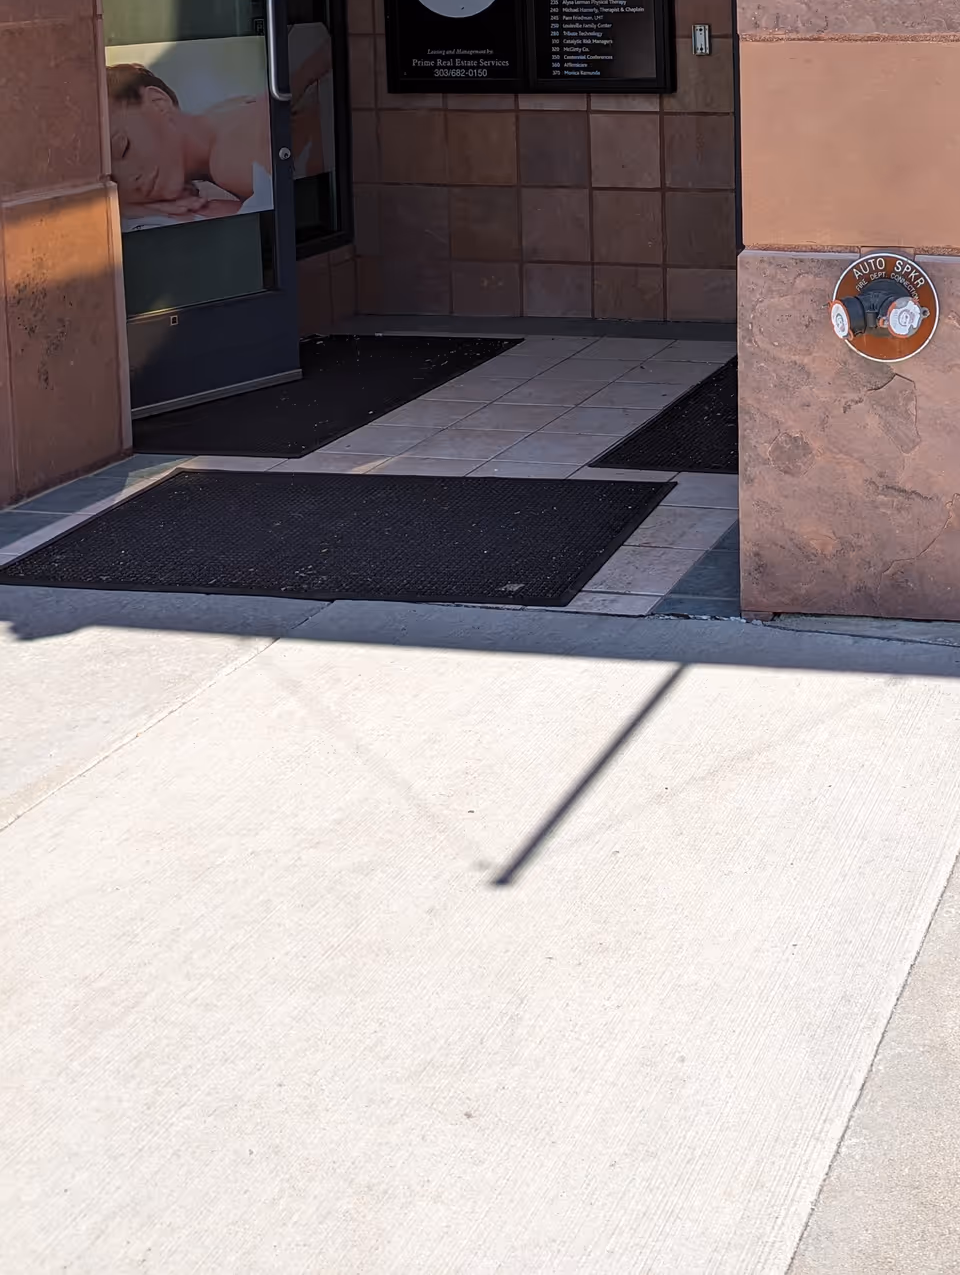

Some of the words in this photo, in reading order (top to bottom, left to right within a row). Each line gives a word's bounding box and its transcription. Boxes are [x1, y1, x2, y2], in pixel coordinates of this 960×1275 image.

[590, 0, 609, 7] Physical
[582, 22, 597, 30] Family
[578, 30, 603, 38] Technology
[591, 38, 613, 46] Managers
[412, 58, 435, 67] Prime
[436, 58, 454, 66] Real
[455, 58, 478, 66] Estate
[479, 58, 509, 67] Services
[433, 68, 488, 78] 303/682-0150
[852, 257, 886, 280] AUTO
[894, 260, 925, 288] SPKR
[855, 279, 869, 292] FIRE
[890, 272, 920, 303] CONNECTION
